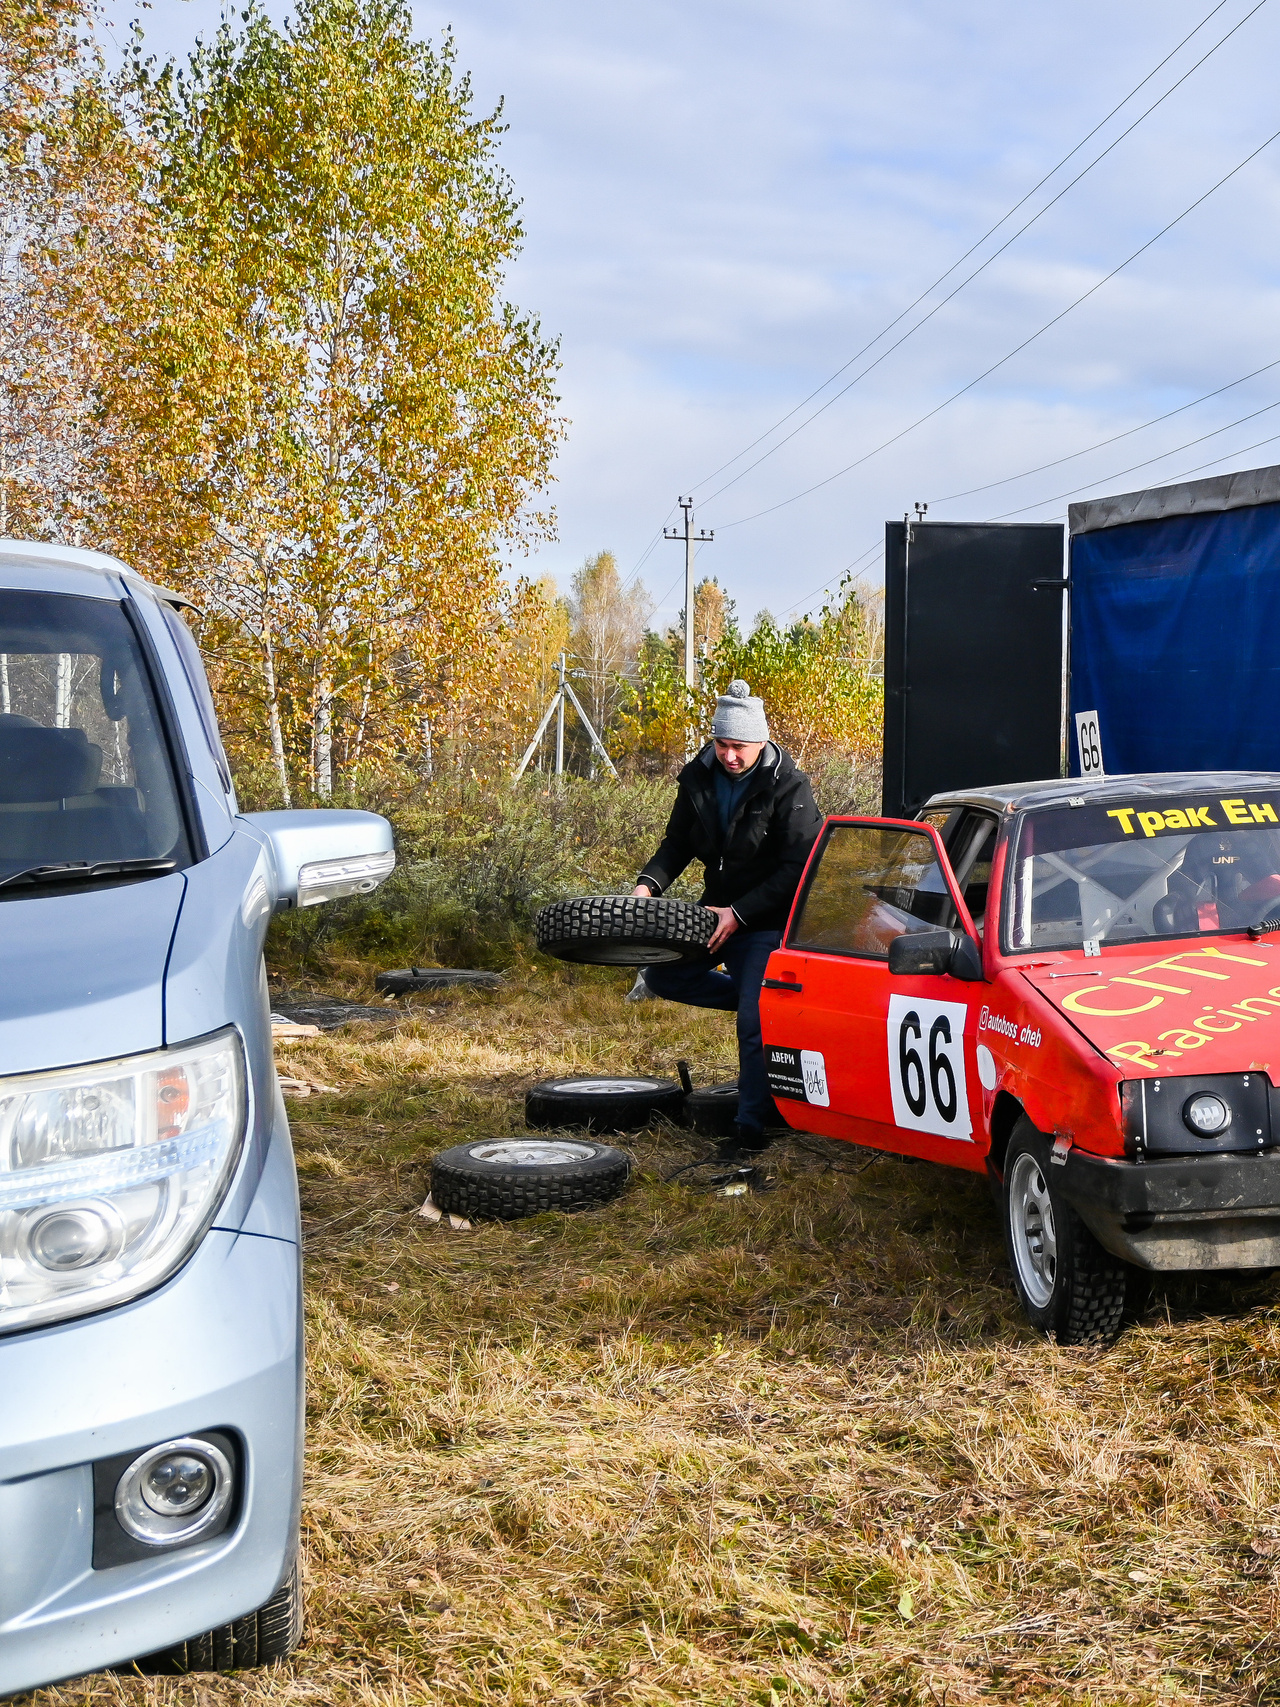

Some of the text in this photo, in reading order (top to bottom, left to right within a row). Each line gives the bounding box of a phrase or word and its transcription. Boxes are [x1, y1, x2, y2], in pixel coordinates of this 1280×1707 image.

[1081, 721, 1100, 771] 66
[1106, 799, 1279, 837] Трак Ен
[1061, 947, 1268, 1016] CITY
[771, 1051, 795, 1065] ДВЕРИ
[899, 1010, 957, 1123] 66
